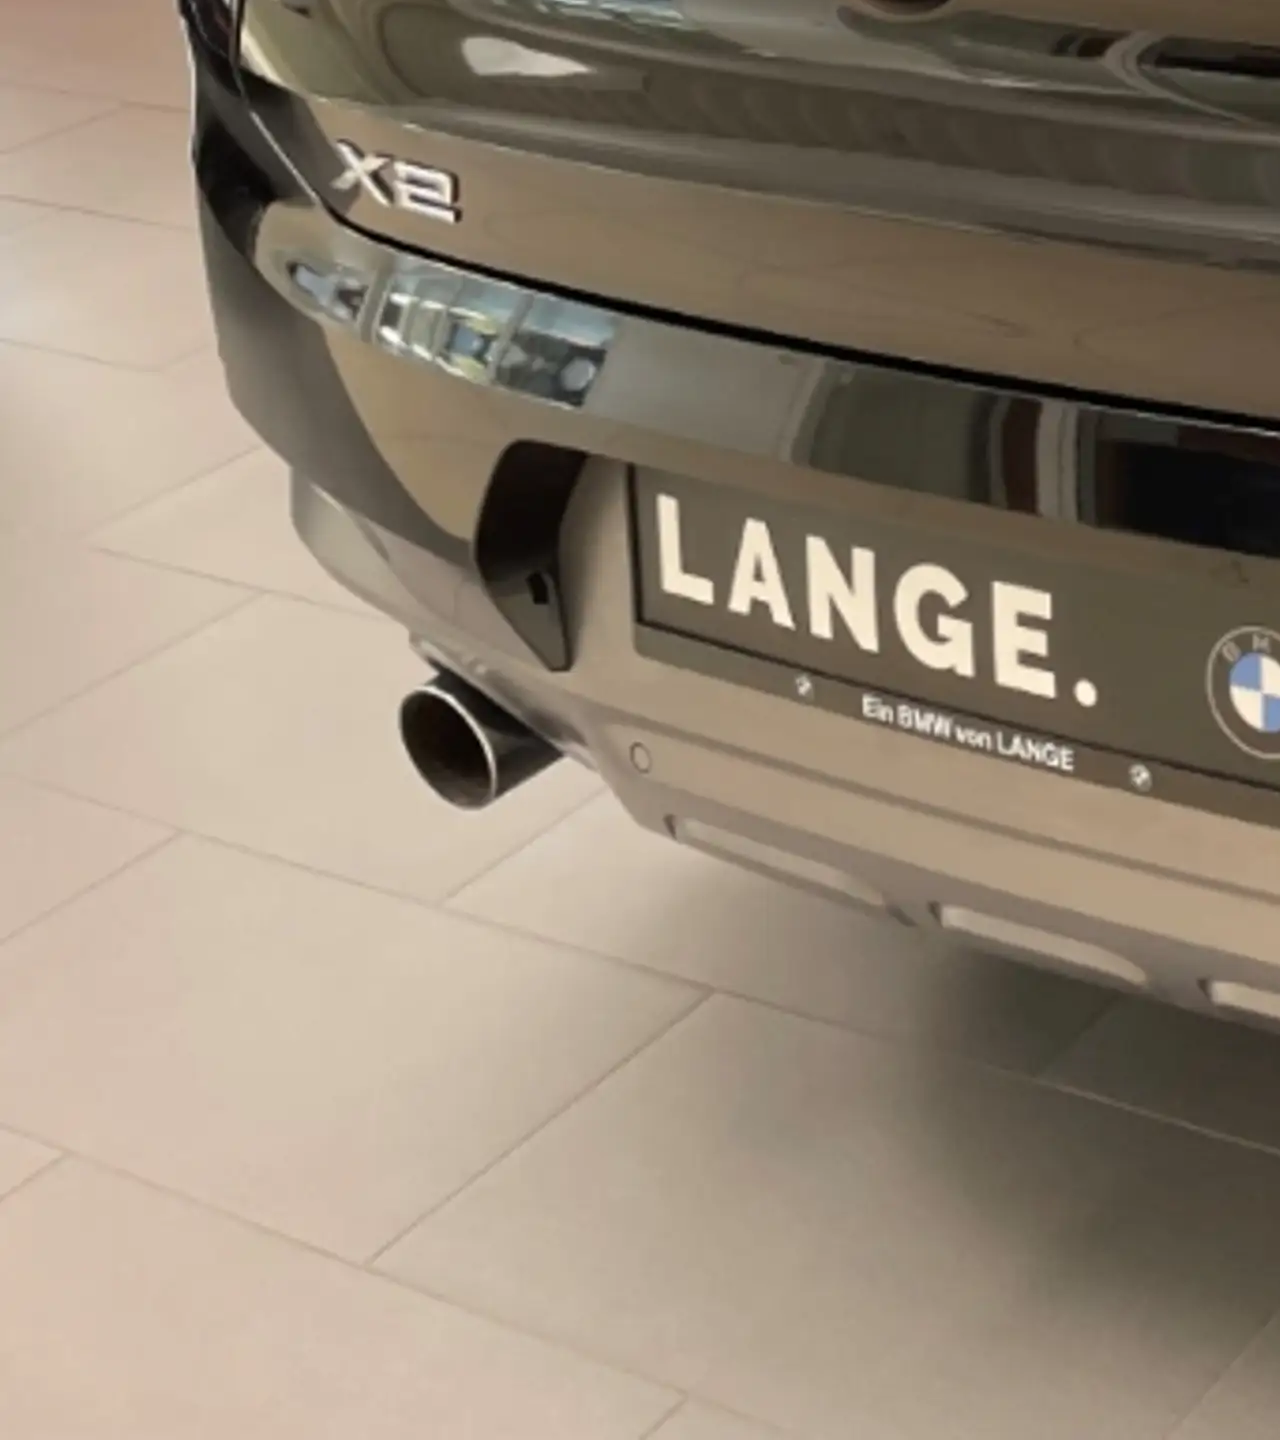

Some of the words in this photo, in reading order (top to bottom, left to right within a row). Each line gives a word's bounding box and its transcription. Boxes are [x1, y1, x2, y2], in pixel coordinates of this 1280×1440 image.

[330, 142, 456, 224] X2
[656, 493, 1098, 708] LANGE.
[861, 693, 894, 725] Ein
[897, 704, 952, 741] BMW
[955, 726, 992, 752] von
[996, 731, 1075, 772] LANGE
